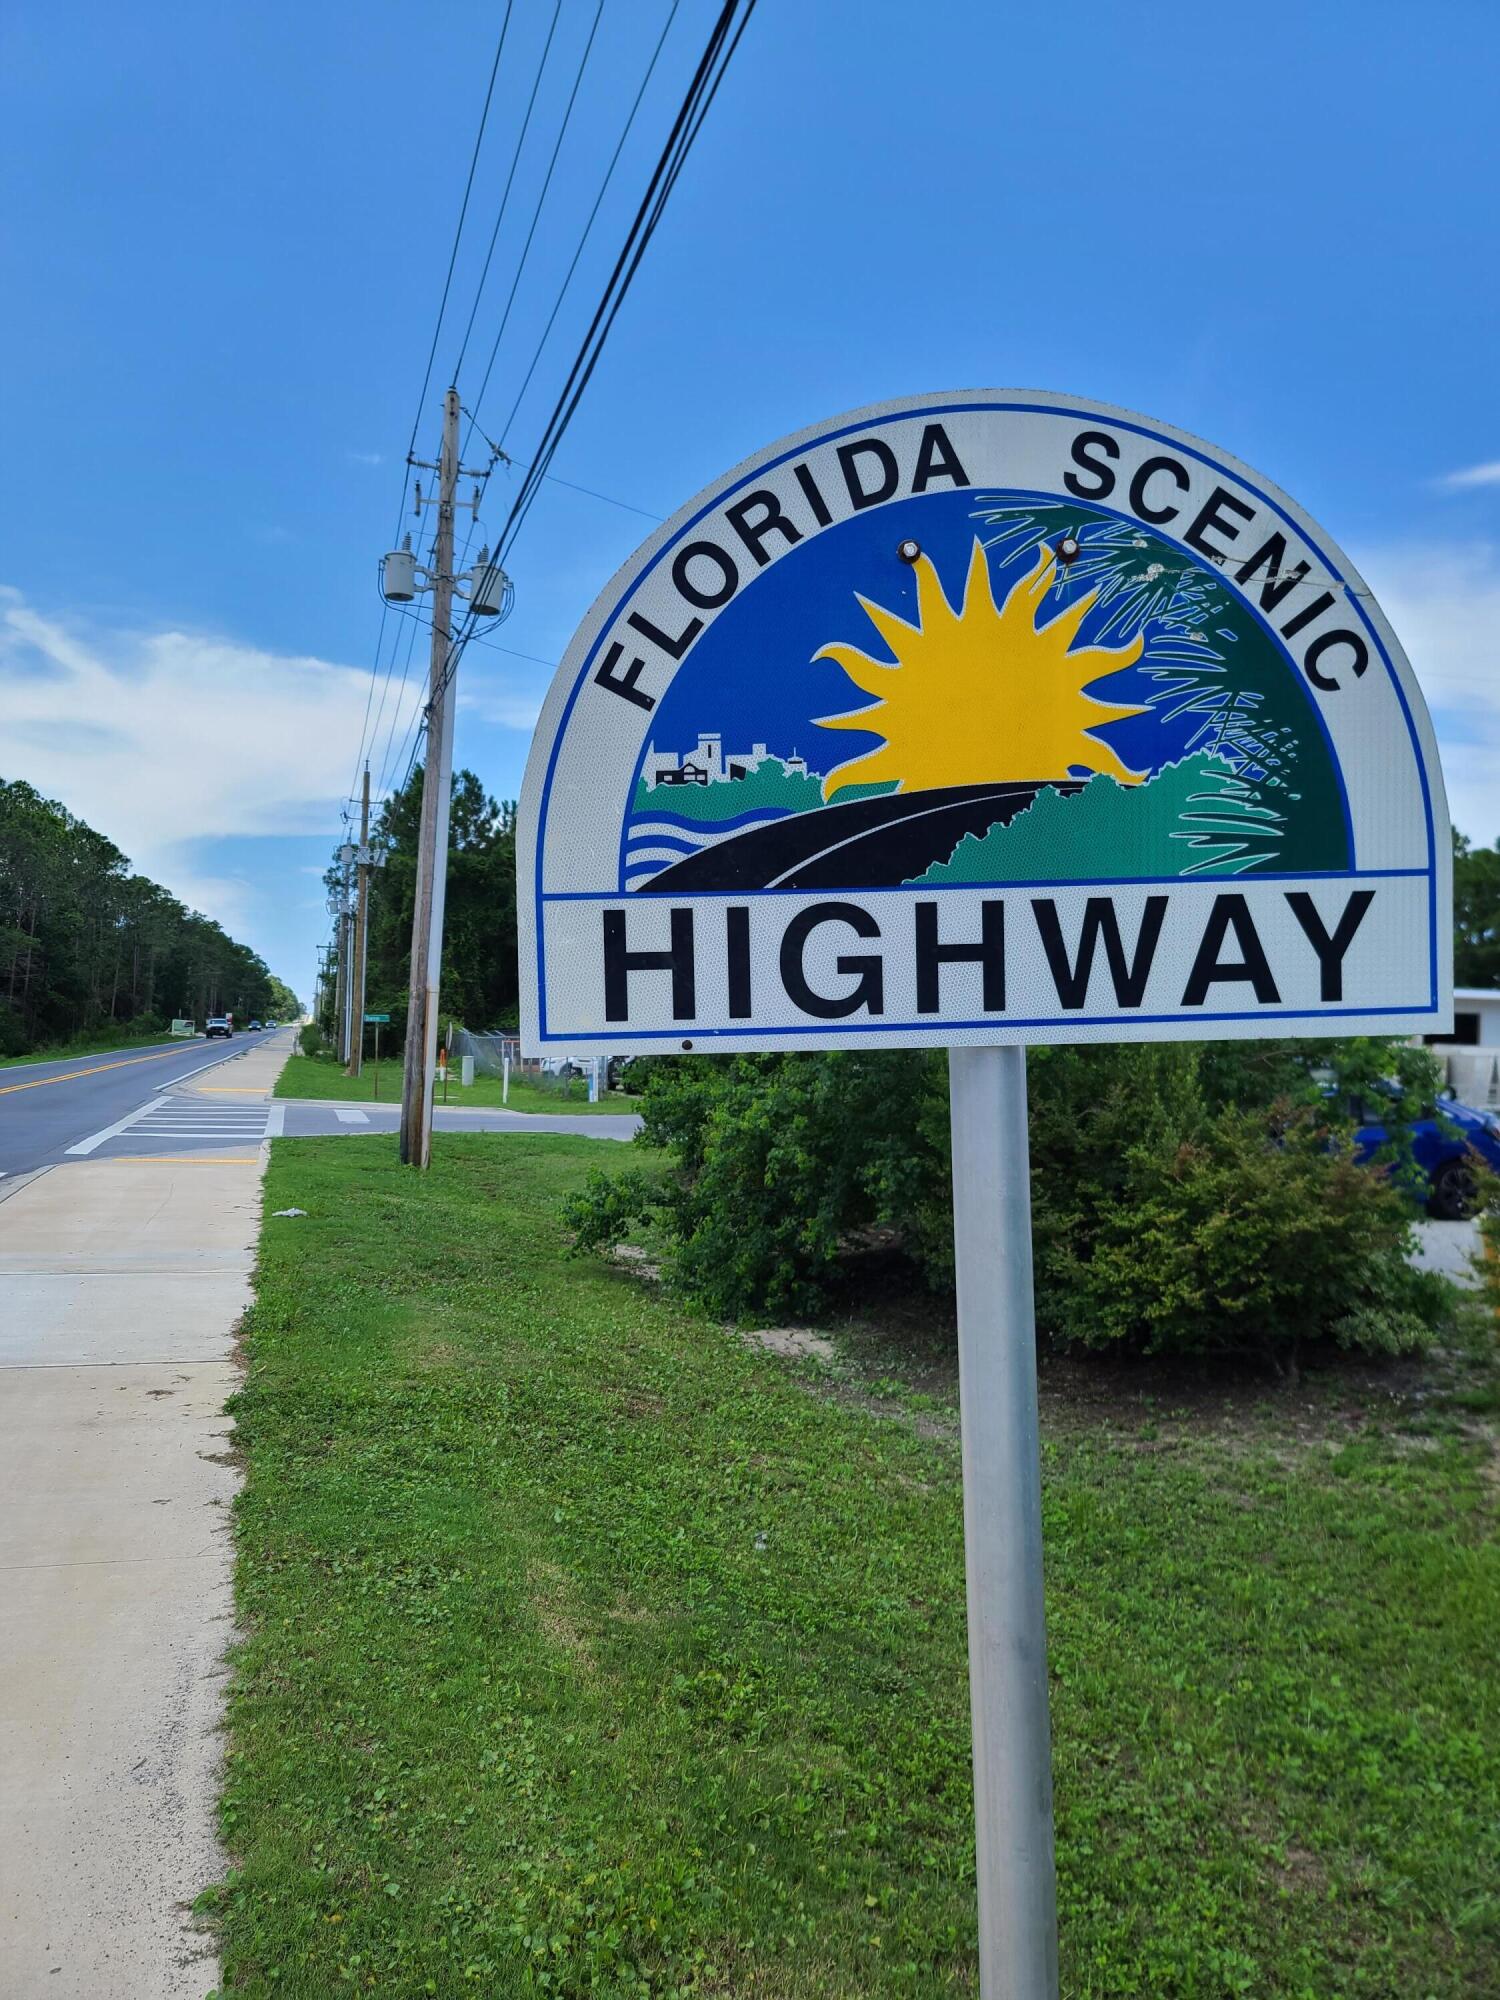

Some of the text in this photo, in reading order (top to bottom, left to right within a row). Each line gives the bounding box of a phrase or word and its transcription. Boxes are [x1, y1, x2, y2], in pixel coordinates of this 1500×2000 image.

[594, 423, 1369, 712] FLORIDA SCENIC
[602, 890, 1376, 1023] HIGHWAY
